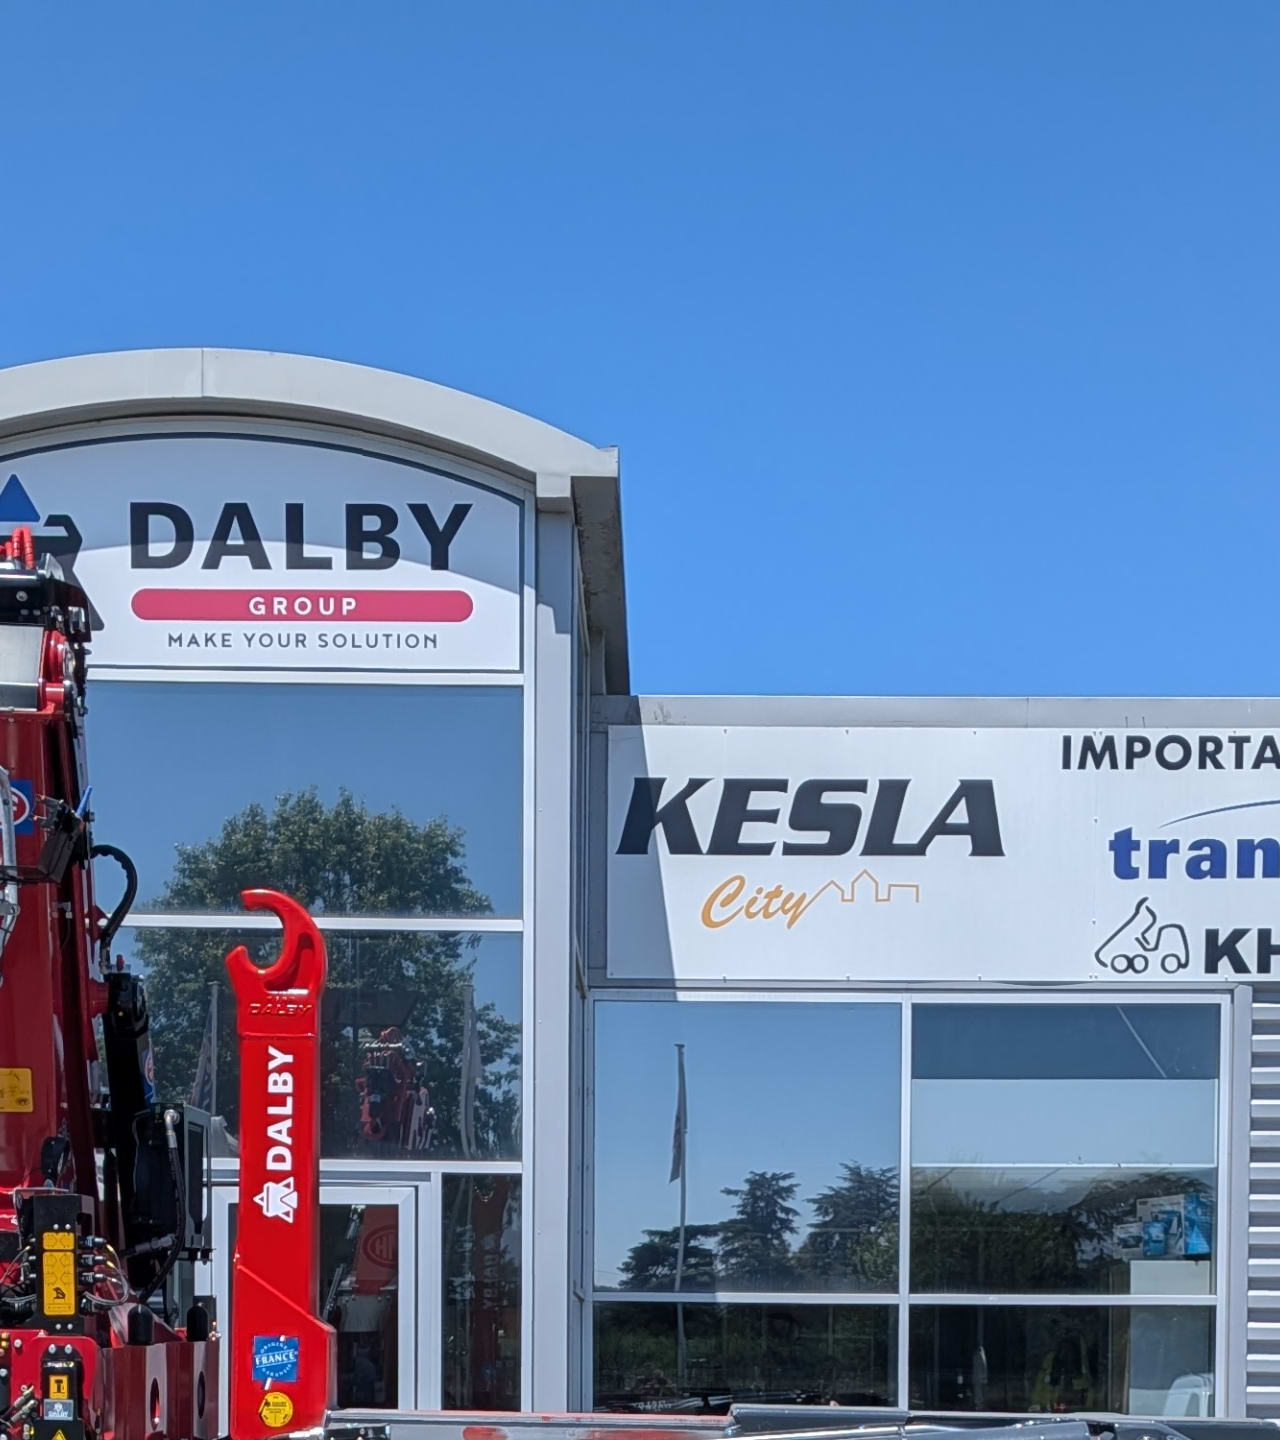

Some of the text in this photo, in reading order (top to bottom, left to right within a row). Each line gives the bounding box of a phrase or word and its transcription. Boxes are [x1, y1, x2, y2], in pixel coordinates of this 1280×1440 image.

[130, 502, 474, 572] DALBY
[248, 596, 358, 616] GROUP
[167, 632, 438, 650] MAKE YOUR SOLUTION
[615, 778, 1006, 858] KESLA
[700, 874, 818, 930] City
[266, 1045, 294, 1172] DALBY
[255, 1351, 296, 1365] FRANCE
